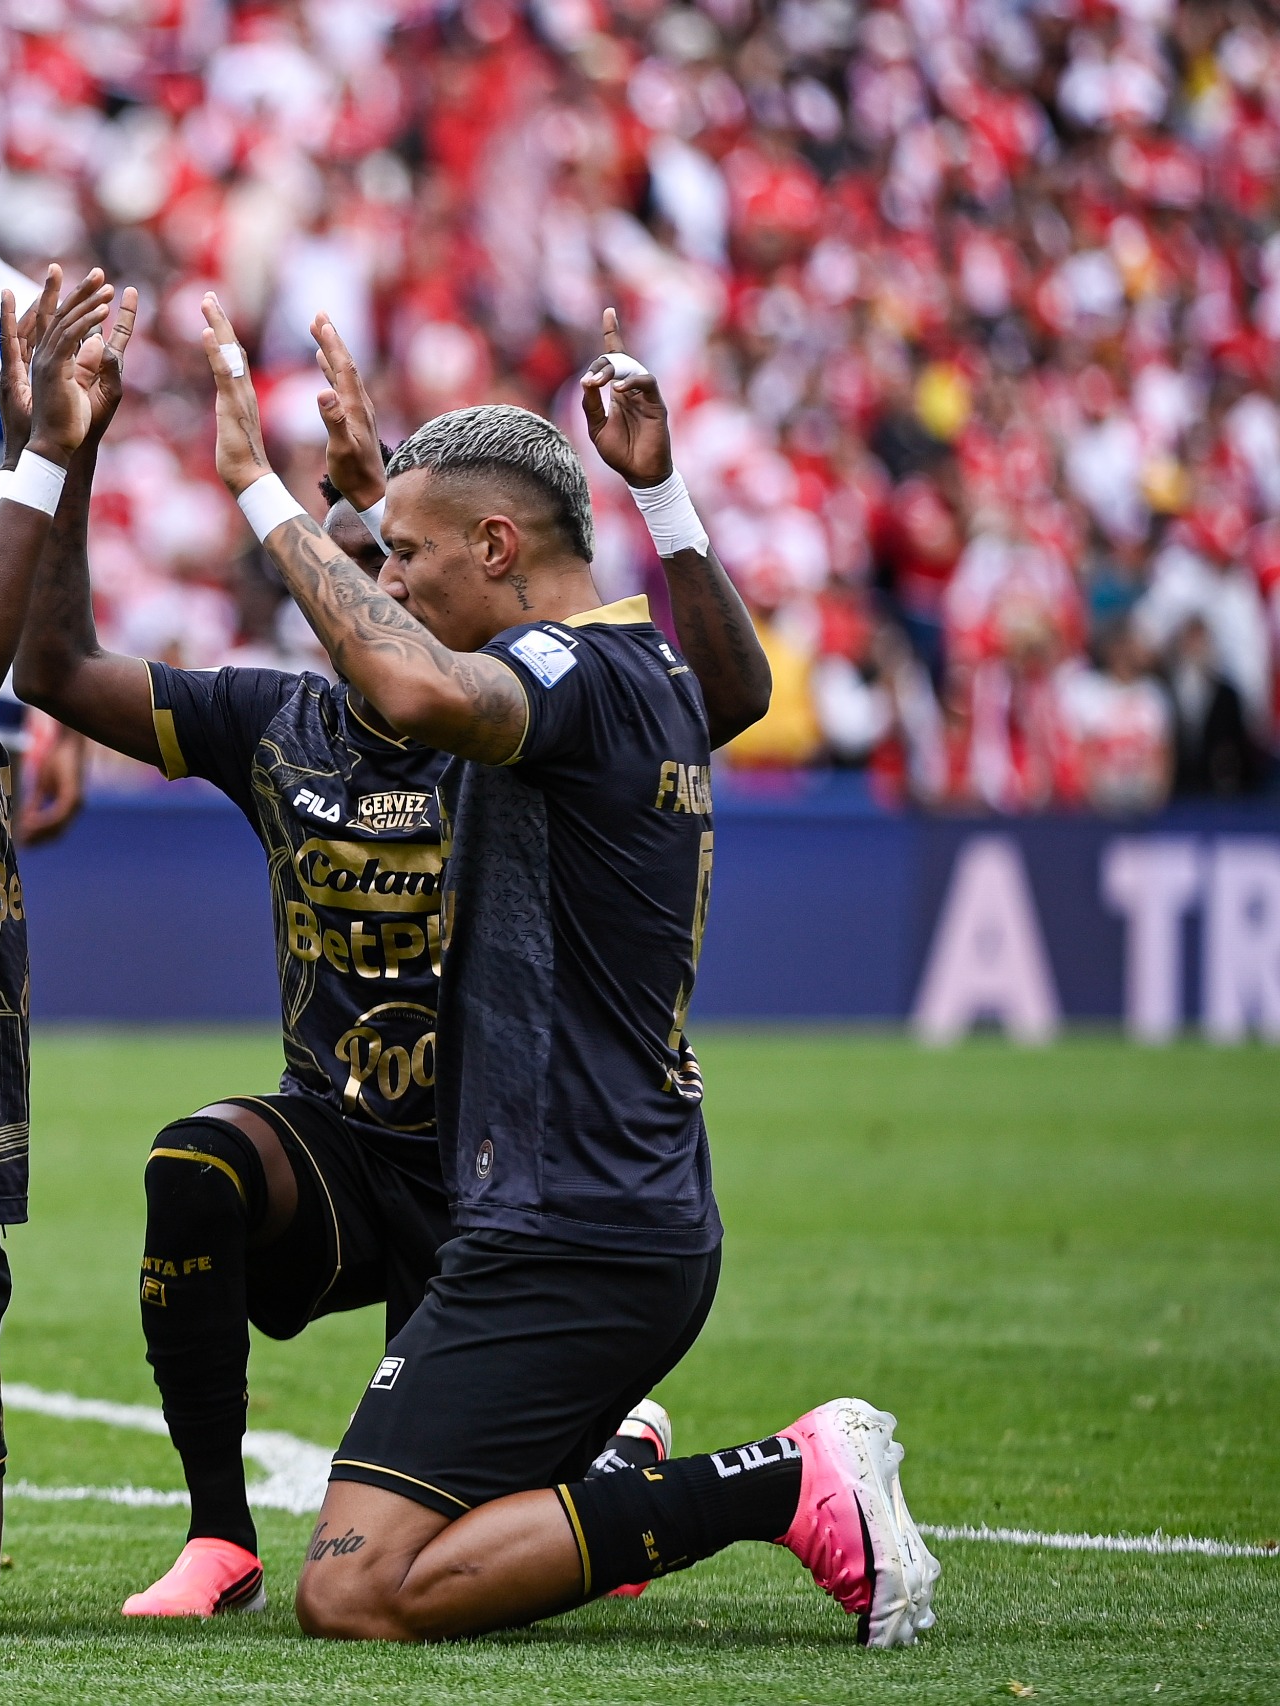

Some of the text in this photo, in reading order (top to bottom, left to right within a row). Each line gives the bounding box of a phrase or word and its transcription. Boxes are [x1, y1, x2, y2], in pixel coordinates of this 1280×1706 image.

[293, 788, 341, 823] FILA
[299, 849, 442, 896] Colan
[910, 832, 1064, 1047] A
[183, 1255, 212, 1275] FE
